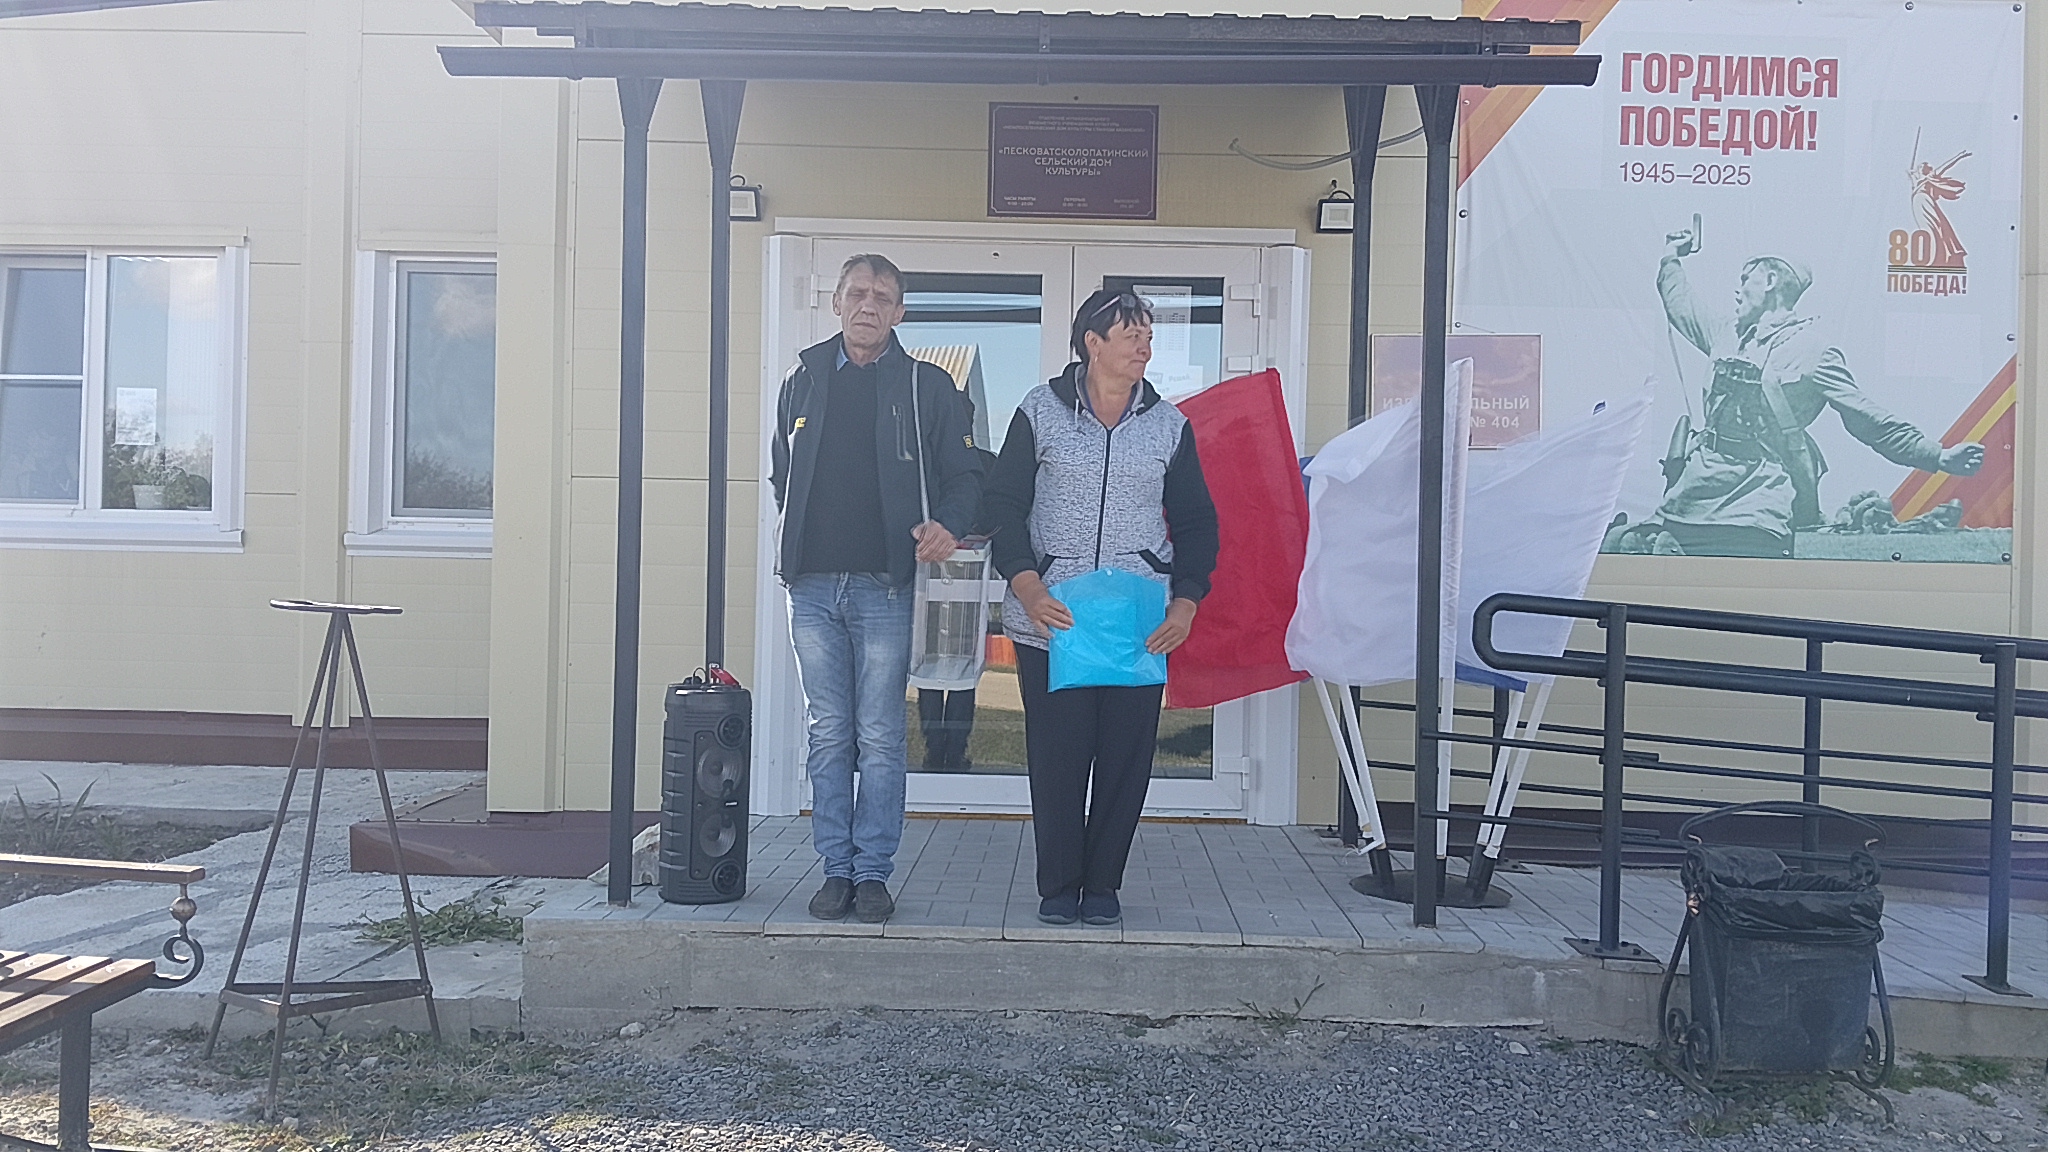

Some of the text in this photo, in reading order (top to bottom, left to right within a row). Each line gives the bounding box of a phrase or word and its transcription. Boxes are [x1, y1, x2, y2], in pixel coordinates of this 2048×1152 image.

[1621, 52, 1838, 102] ГОРДИМСЯ
[1619, 104, 1818, 156] ПОБЕДОЙ!
[999, 146, 1149, 158] «ПЕСКОВАТСКОЛОПАТИНСКИЙ
[1034, 156, 1112, 168] СЕЛЬСКИЙ ДОМ
[1045, 167, 1101, 177] КУЛЬТУРЫ»
[1888, 229, 1932, 267] 80
[1887, 274, 1967, 297] ПОБЕДА!
[1470, 416, 1520, 428] № 404
